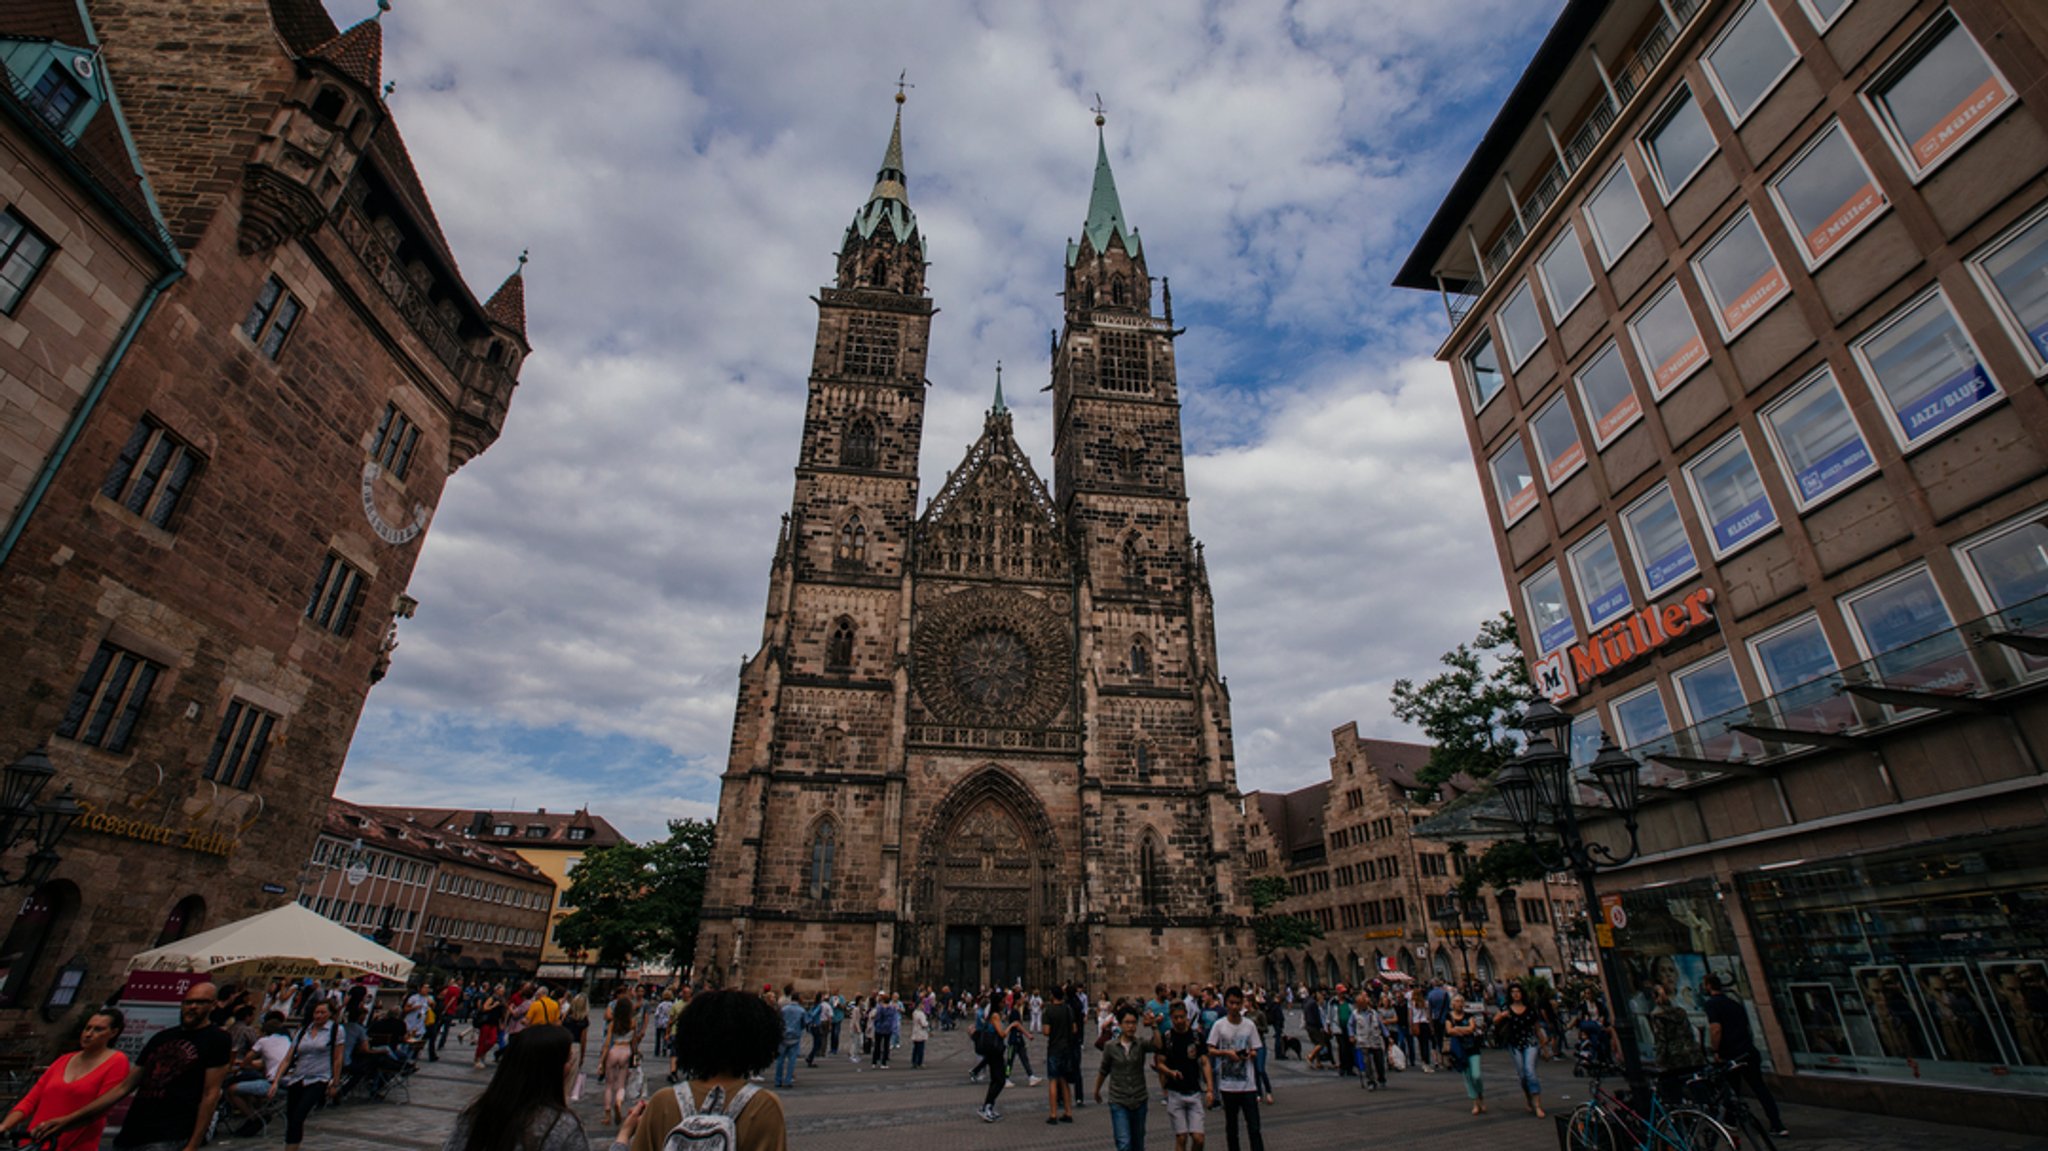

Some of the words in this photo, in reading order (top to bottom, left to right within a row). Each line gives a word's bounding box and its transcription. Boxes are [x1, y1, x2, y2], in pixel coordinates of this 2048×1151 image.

[1938, 91, 1996, 143] Müller
[1828, 195, 1873, 237] Müller
[1740, 279, 1777, 312] Müller
[1910, 376, 1986, 428] JAZZ/BLUES
[1727, 509, 1763, 538] KLASSIK
[1569, 588, 1715, 684] Müller
[75, 799, 172, 846] Nassauer
